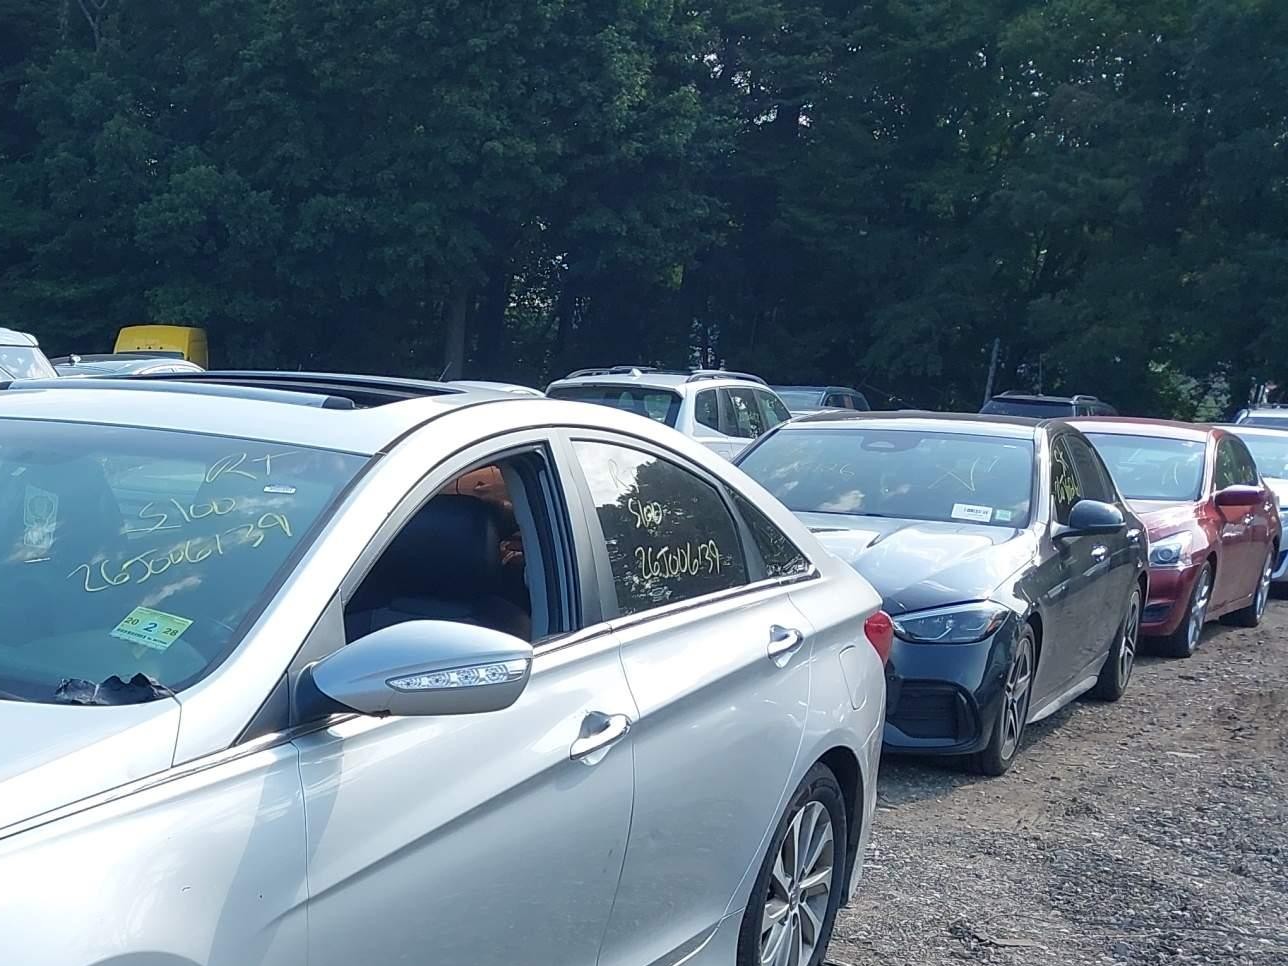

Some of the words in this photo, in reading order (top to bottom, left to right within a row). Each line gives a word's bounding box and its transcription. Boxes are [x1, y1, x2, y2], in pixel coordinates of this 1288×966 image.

[124, 616, 140, 626] 20
[143, 622, 158, 632] 2
[162, 627, 179, 636] 28
